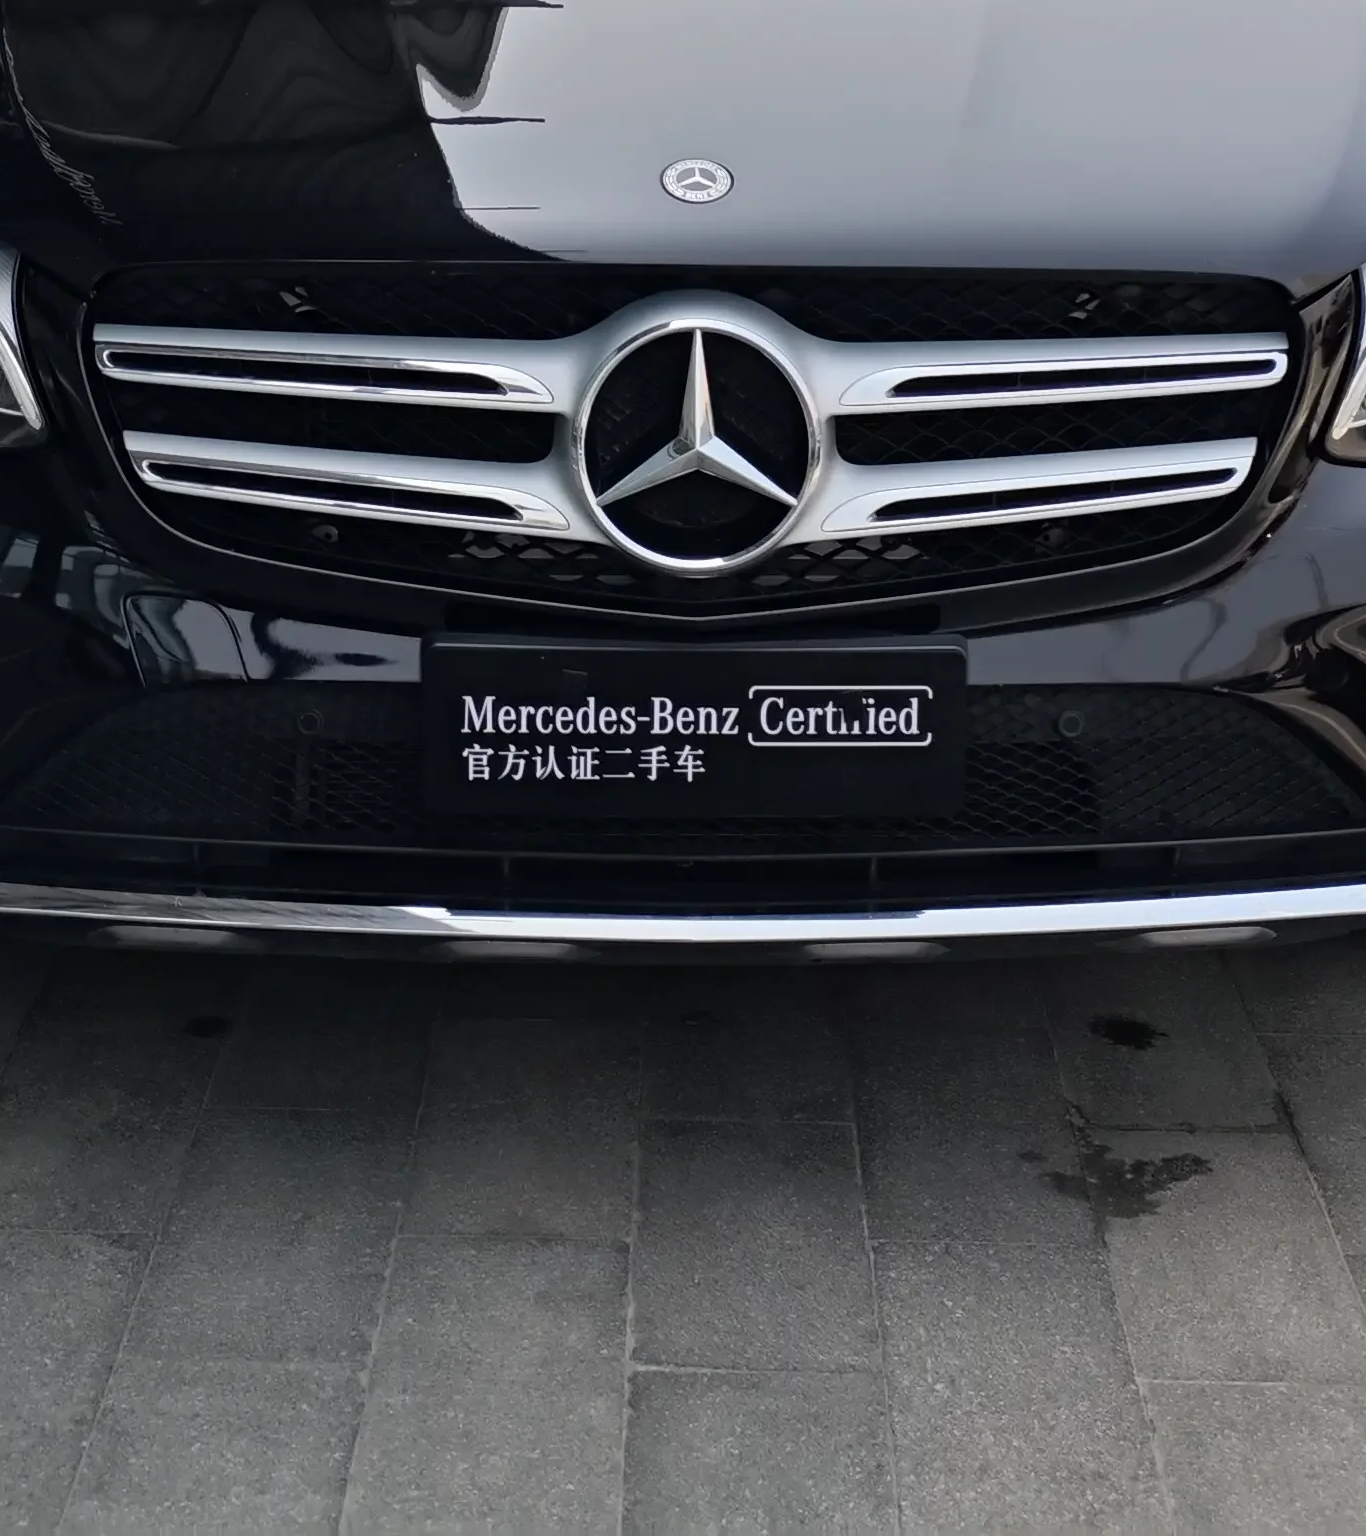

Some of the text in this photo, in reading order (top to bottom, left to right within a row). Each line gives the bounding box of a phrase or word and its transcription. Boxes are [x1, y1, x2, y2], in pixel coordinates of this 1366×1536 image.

[460, 695, 739, 736] Mercedes-Benz
[461, 743, 706, 783] 官方认证二手车
